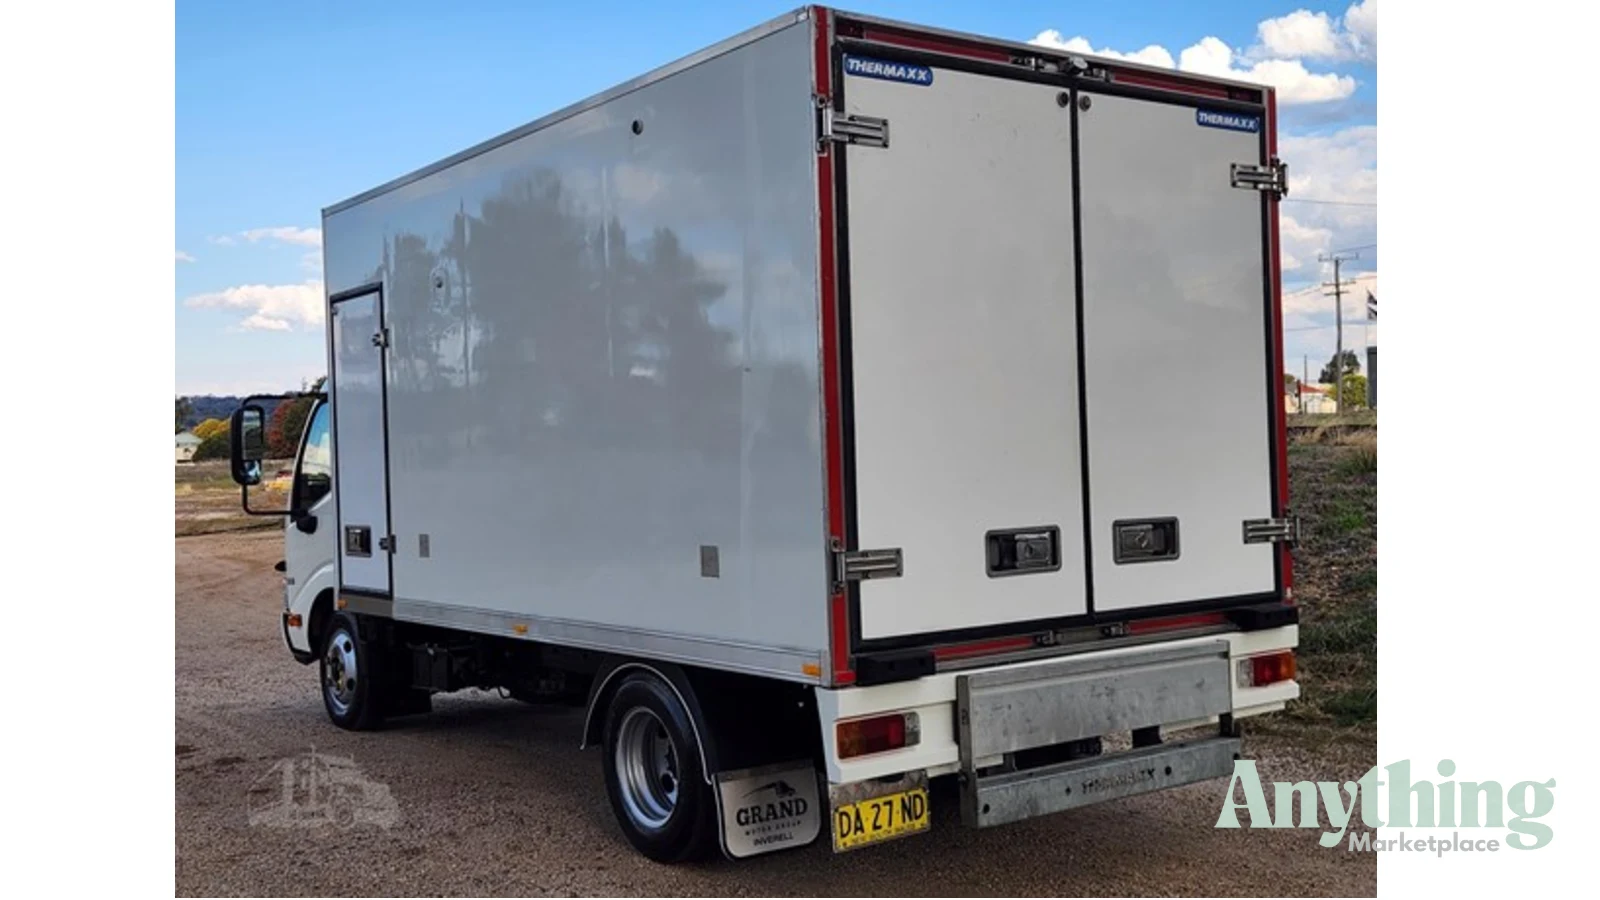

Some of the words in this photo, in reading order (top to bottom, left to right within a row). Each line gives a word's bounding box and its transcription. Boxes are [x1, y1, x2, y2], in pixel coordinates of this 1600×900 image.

[848, 58, 928, 81] THERMAXX
[1199, 112, 1257, 130] THERMAXX
[736, 798, 808, 826] GRAND
[839, 806, 865, 838] DA
[871, 799, 894, 831] 27
[901, 793, 925, 824] ND
